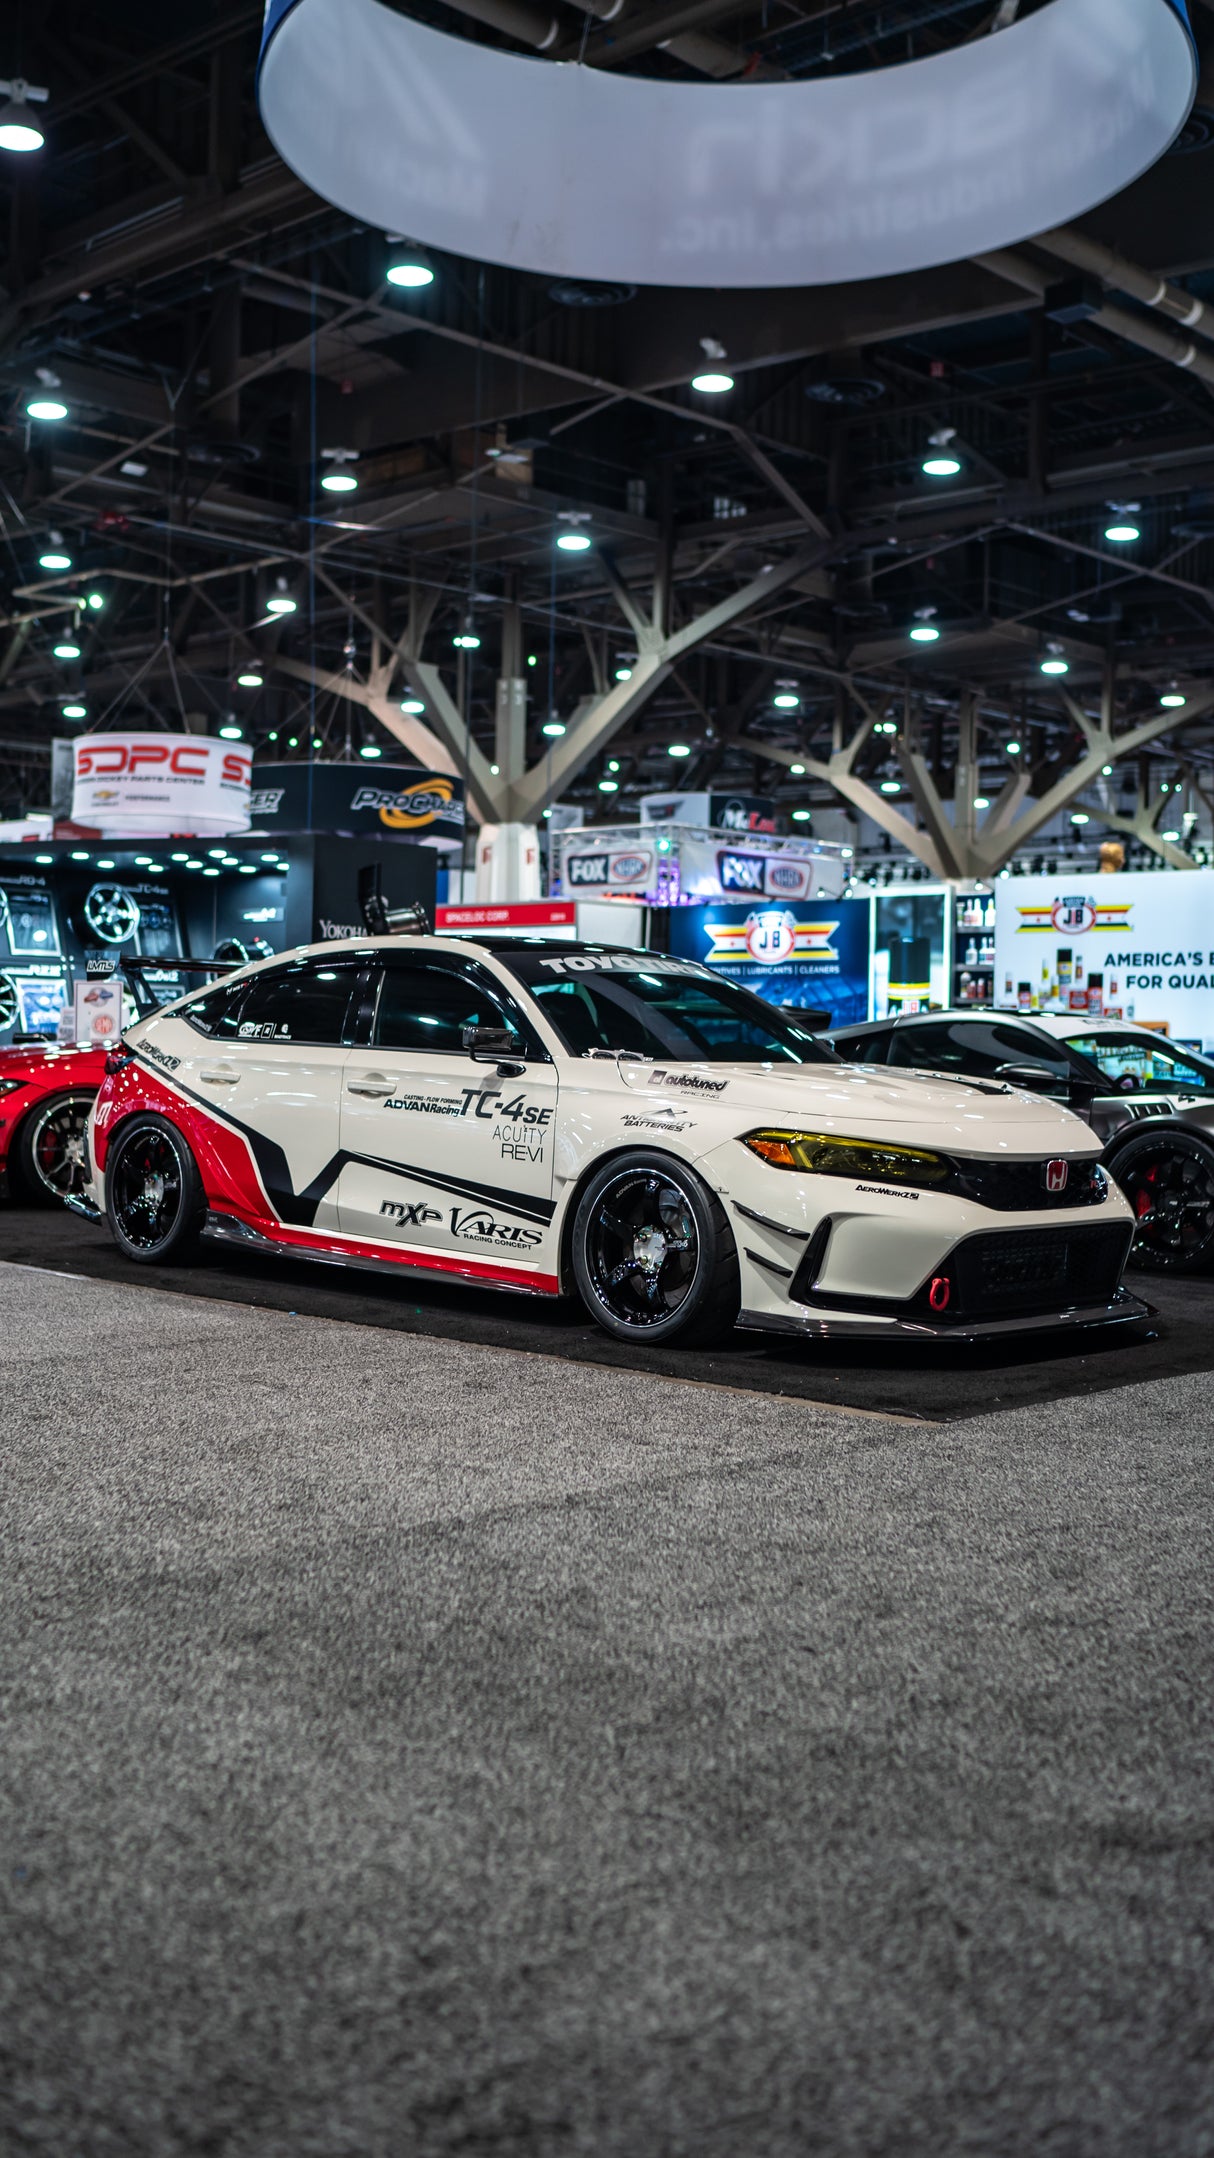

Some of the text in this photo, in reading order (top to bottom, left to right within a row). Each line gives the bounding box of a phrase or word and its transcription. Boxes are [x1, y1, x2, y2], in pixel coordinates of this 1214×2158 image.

[571, 858, 607, 881] FOX
[722, 857, 763, 889] FOX
[1104, 952, 1203, 967] AMERICA'S
[747, 966, 793, 975] LUBRICANTS
[799, 965, 840, 975] CLEANERS
[1126, 975, 1162, 989] FOR
[665, 1075, 730, 1092] autotuned
[404, 1094, 463, 1105] CASTING FLOW FORMING
[680, 1090, 721, 1100] RACING
[624, 1121, 685, 1132] BATTERIES
[463, 1233, 532, 1251] RACING CONCEPT
